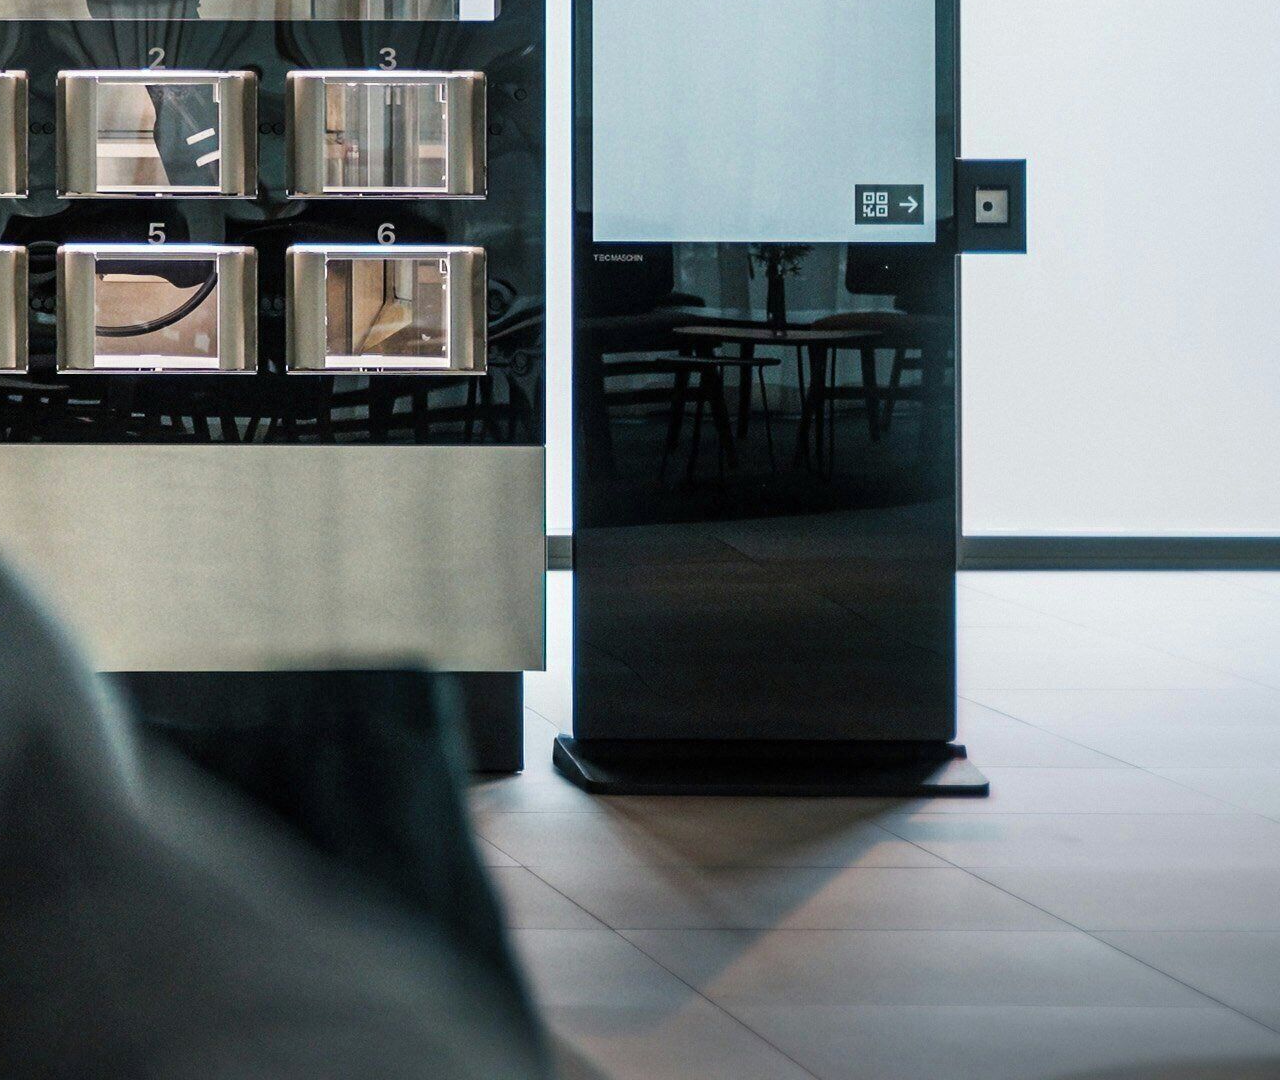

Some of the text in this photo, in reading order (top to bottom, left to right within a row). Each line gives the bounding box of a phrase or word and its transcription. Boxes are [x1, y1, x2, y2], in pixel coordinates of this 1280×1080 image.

[148, 47, 166, 69] 2
[379, 47, 397, 70] 3
[148, 222, 166, 244] 5
[377, 222, 395, 245] 6
